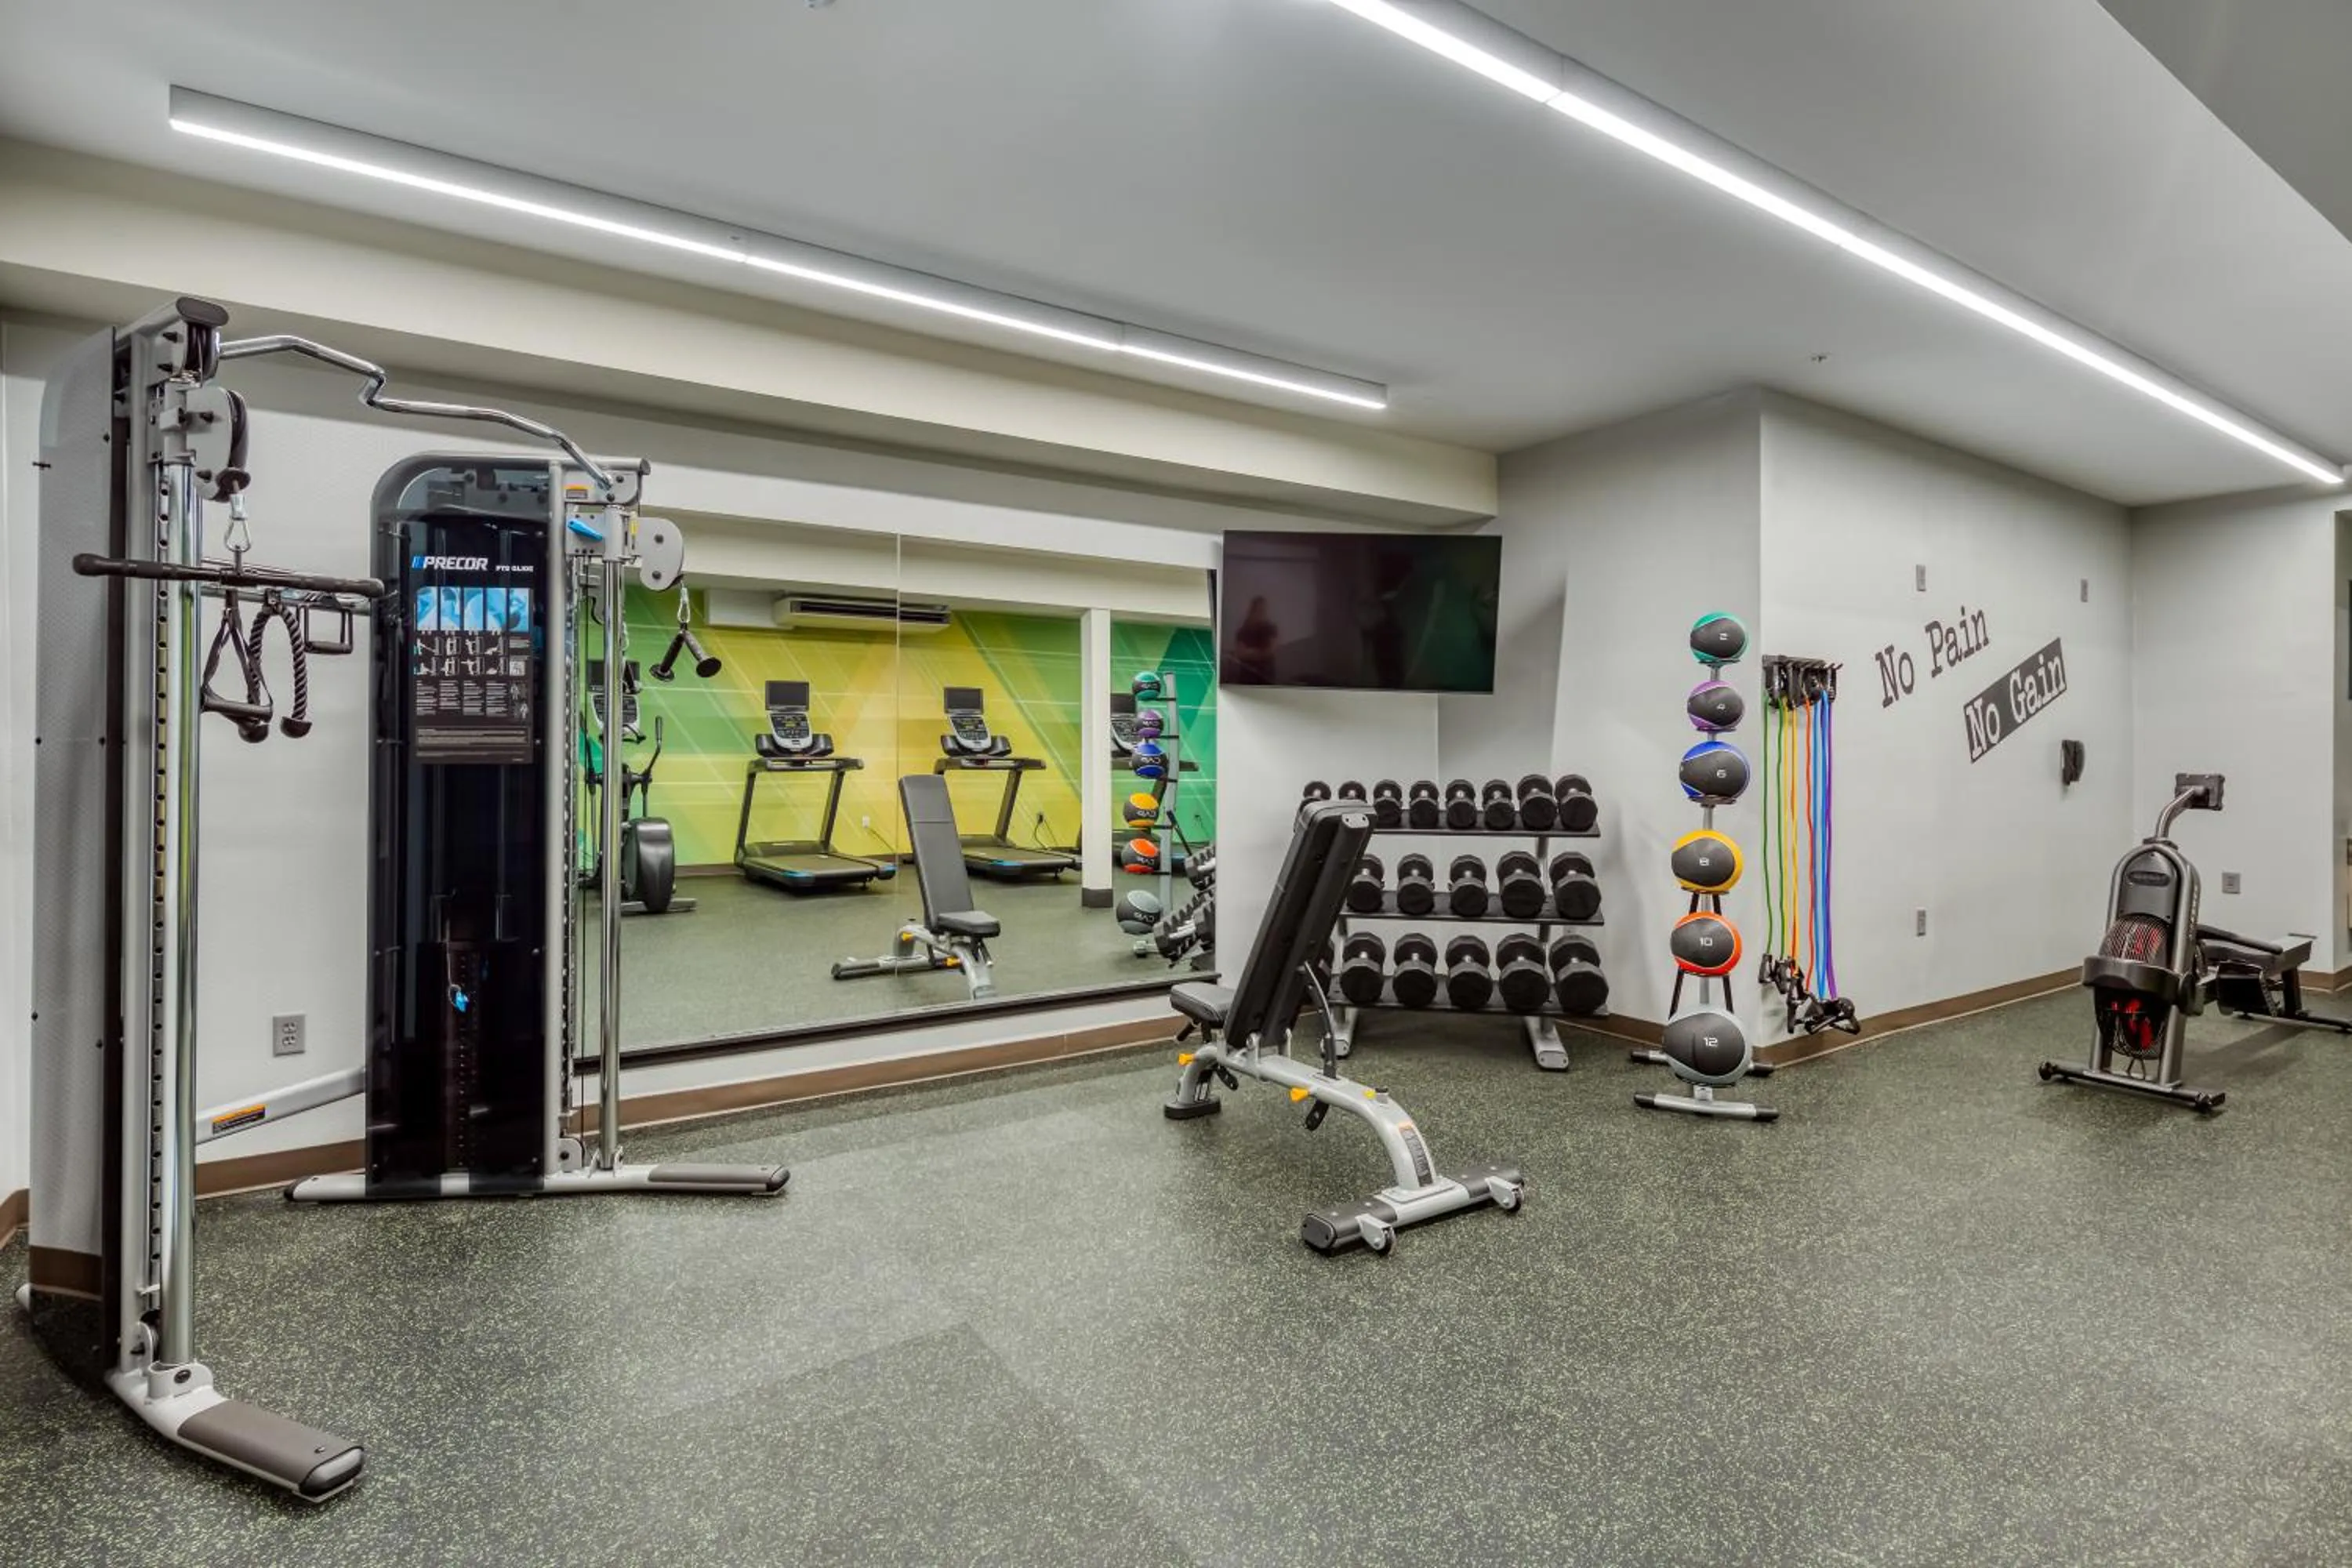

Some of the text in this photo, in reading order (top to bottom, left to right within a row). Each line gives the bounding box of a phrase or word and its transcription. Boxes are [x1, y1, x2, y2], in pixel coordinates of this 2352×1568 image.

[423, 556, 489, 571] PRECOR
[1875, 605, 1990, 709] No Pain
[1965, 653, 2067, 758] No Gain
[1716, 769, 1726, 779] 6
[1699, 937, 1713, 946] 10
[1703, 1036, 1719, 1047] 12
